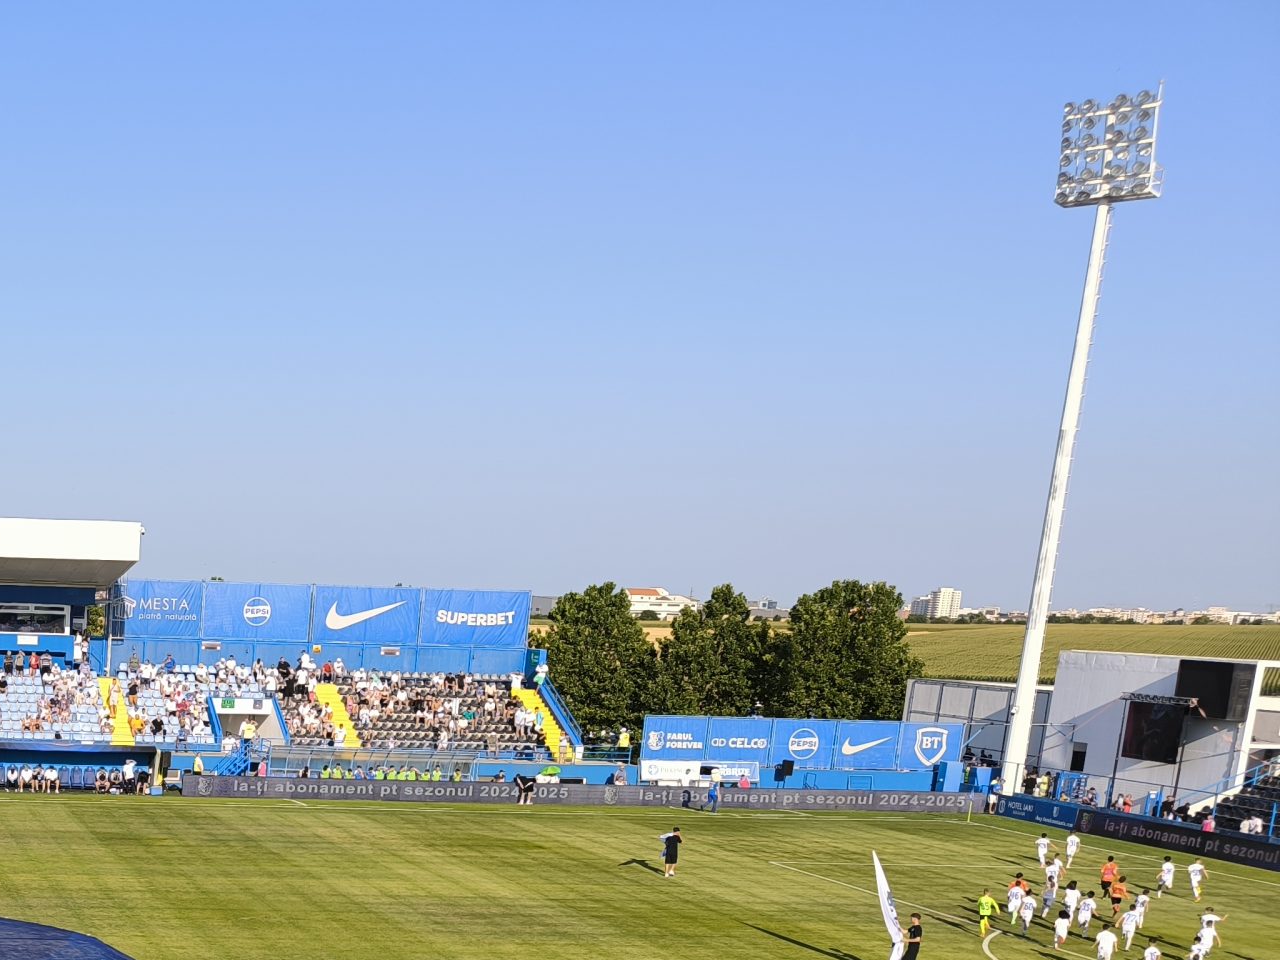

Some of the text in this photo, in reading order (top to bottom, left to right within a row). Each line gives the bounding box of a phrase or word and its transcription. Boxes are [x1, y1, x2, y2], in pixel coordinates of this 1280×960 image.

[139, 597, 189, 611] MESTA
[436, 609, 515, 626] SUPERBET
[667, 732, 693, 741] FARUL
[728, 737, 767, 749] CELCO
[921, 736, 942, 749] BT
[665, 741, 703, 749] FOREVER
[790, 739, 817, 748] PEPSI
[274, 780, 373, 795] abonament
[380, 783, 397, 797] pt
[404, 784, 473, 797] sezonul
[783, 792, 800, 805] pt
[806, 793, 873, 805] sezonul
[879, 794, 966, 807] 2024-2025
[1131, 823, 1201, 848] abonament
[1204, 842, 1221, 852] pt
[1223, 843, 1280, 864] sezonul
